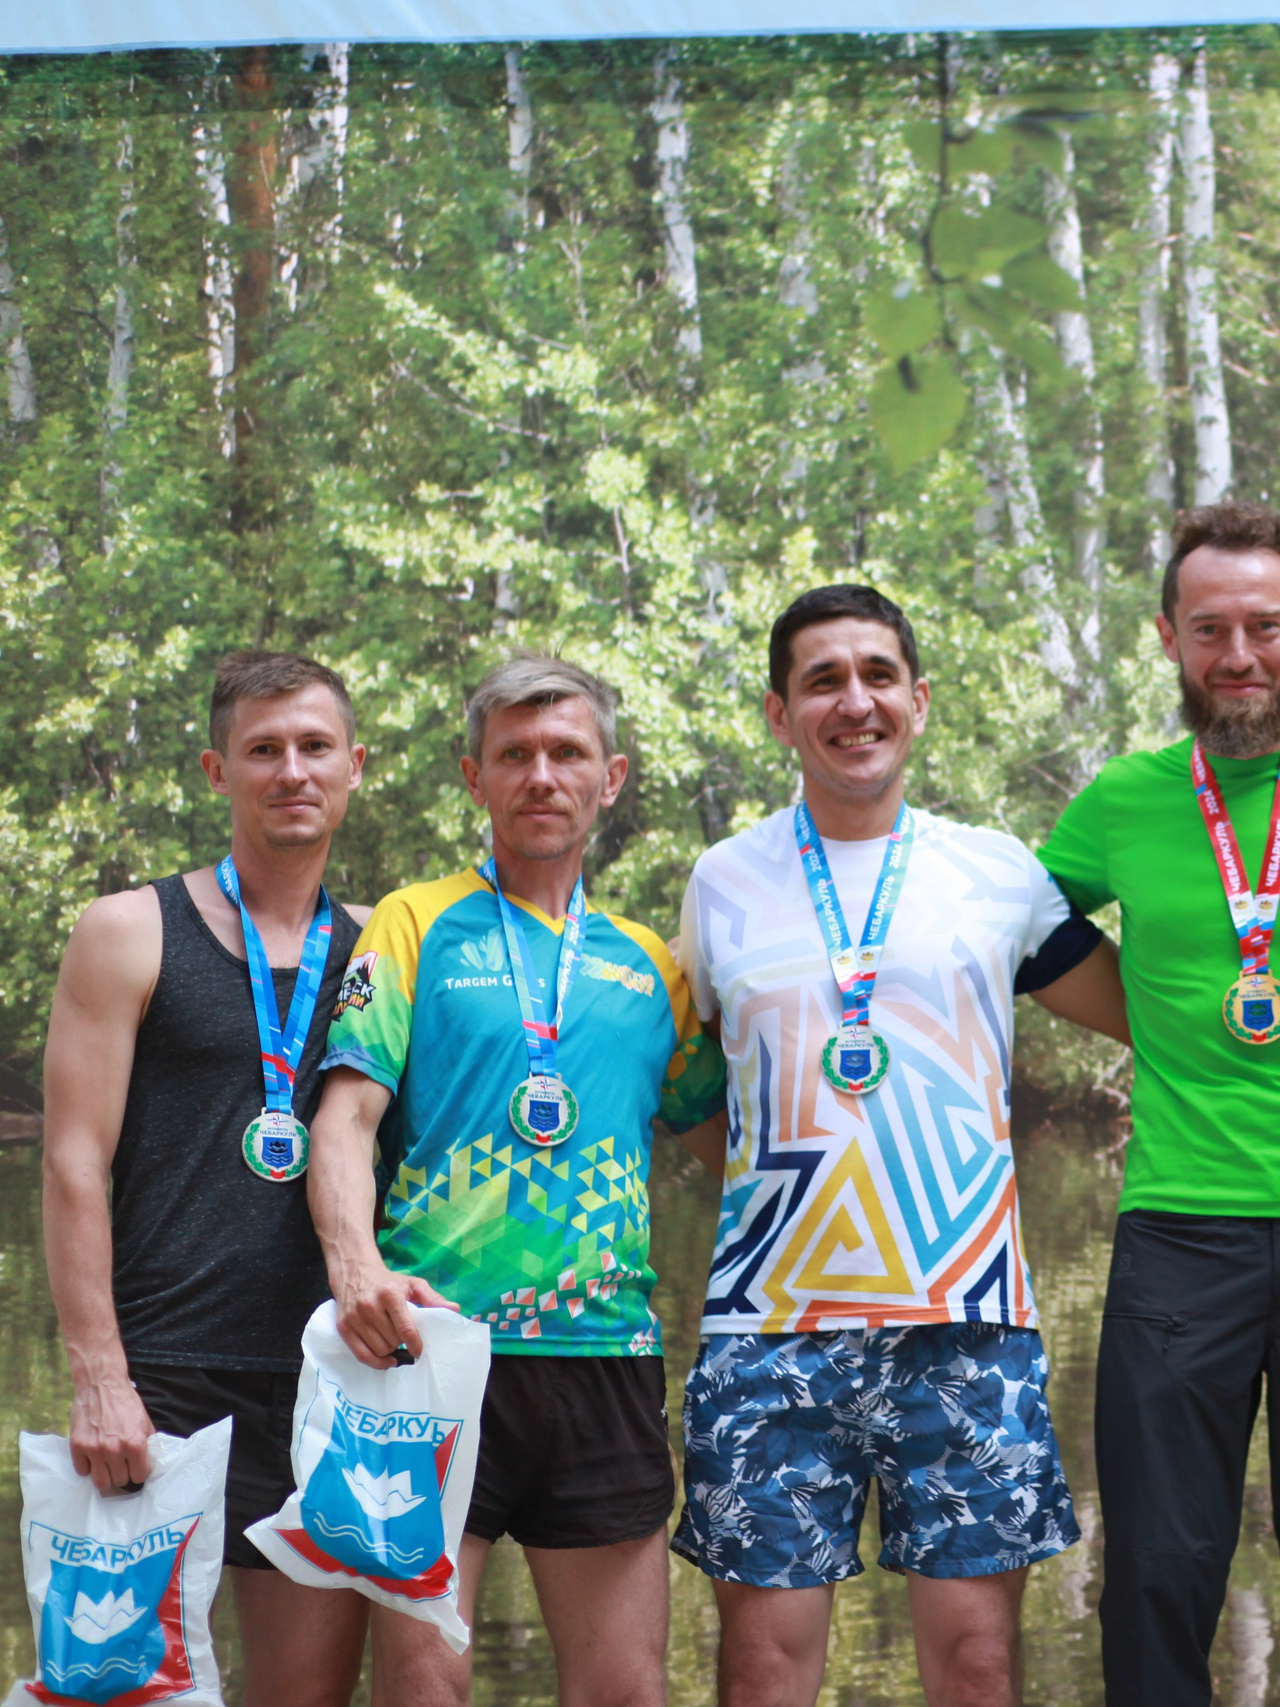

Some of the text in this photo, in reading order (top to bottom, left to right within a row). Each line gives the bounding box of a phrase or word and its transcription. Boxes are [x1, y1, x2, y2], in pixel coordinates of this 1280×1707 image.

[1204, 789, 1241, 892] ЧЕБАРКУЛЬ 2024
[807, 848, 842, 947] ЧЕБАРКУЛЬ 2024
[868, 843, 903, 940] ЧЕБАРКУЛЬ 2024
[335, 1389, 446, 1445] ЧЕБАРКУЬ
